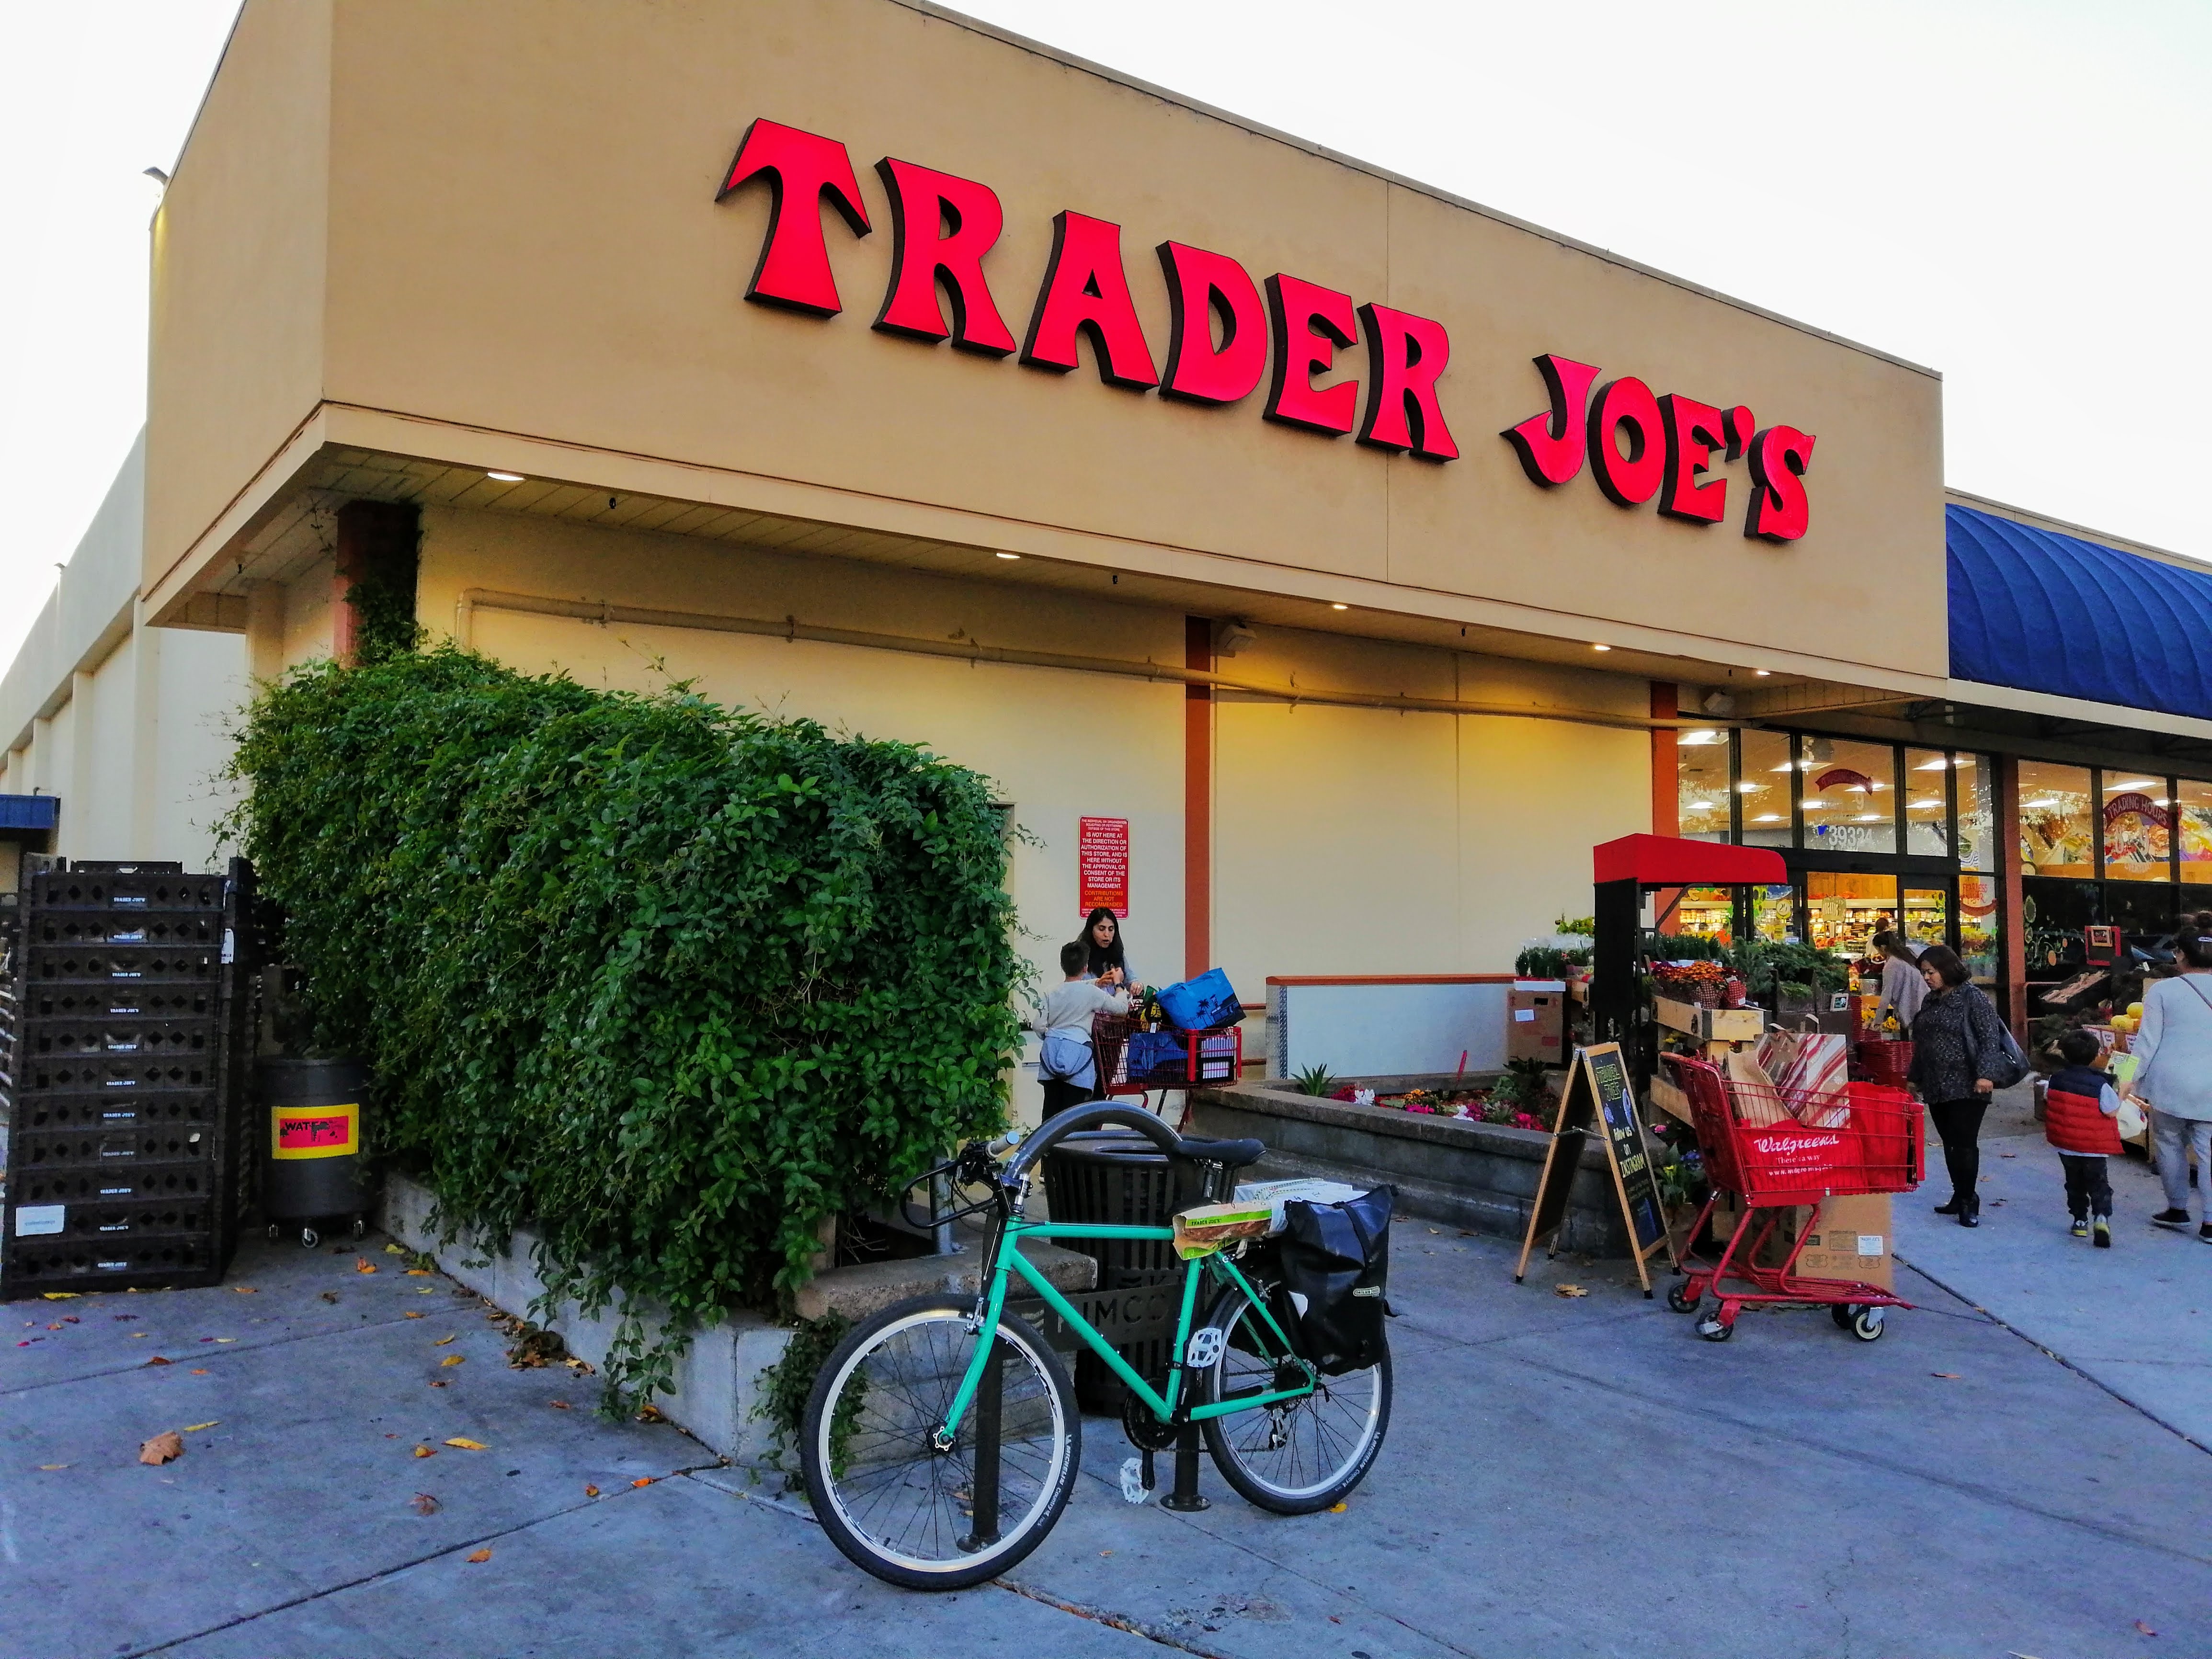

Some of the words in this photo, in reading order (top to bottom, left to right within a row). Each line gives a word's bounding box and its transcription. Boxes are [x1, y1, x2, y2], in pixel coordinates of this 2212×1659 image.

[715, 118, 1459, 463] TRADER
[1499, 354, 1816, 545] JOE'S
[2108, 795, 2139, 818] TRADING
[1828, 825, 1874, 848] 39324
[1754, 1134, 1839, 1156] Walgreens
[1776, 1155, 1801, 1164] There's
[1059, 1445, 1071, 1486] MICHELIN
[1360, 1439, 1377, 1469] MICHELIN
